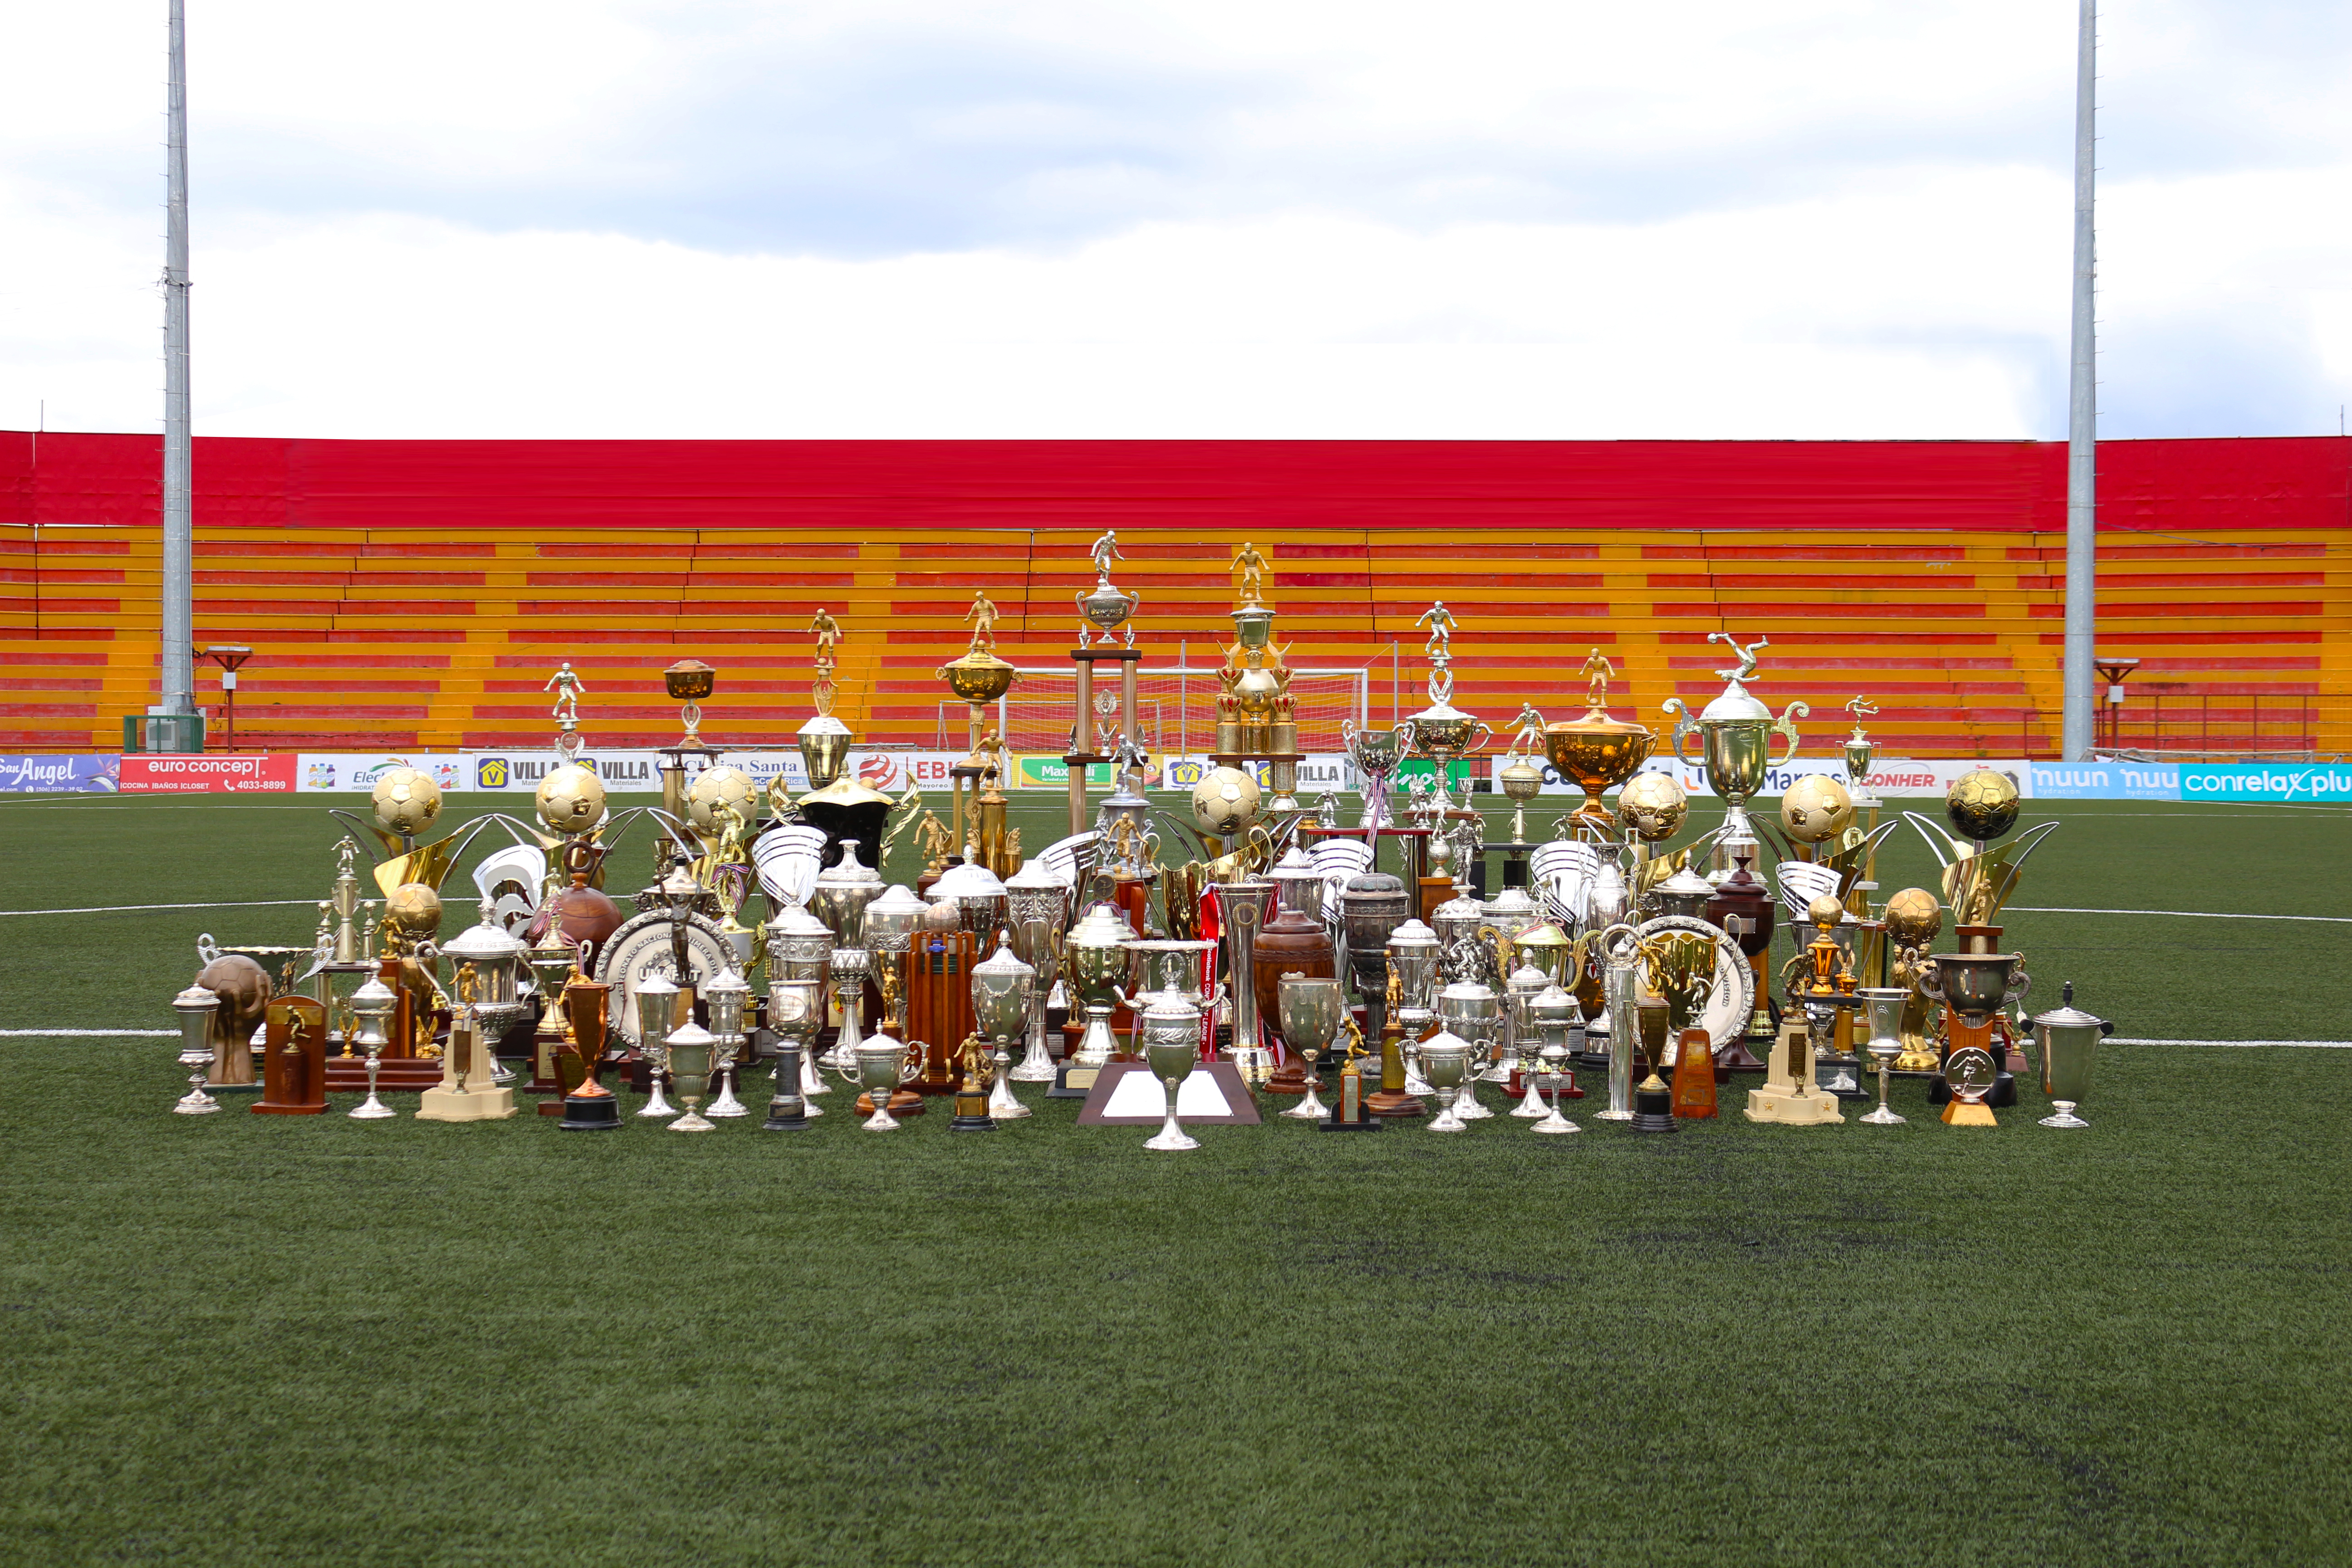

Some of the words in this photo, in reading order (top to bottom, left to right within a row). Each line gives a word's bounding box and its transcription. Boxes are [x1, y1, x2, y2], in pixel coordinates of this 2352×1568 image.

[11, 758, 77, 785] Angel
[148, 761, 186, 773] euro
[602, 761, 649, 779] VILLA
[750, 760, 798, 772] Santa
[353, 771, 385, 783] Elec
[1860, 773, 1935, 787] GONHER
[2032, 768, 2109, 787] nuun
[237, 780, 286, 789] 4033-8899
